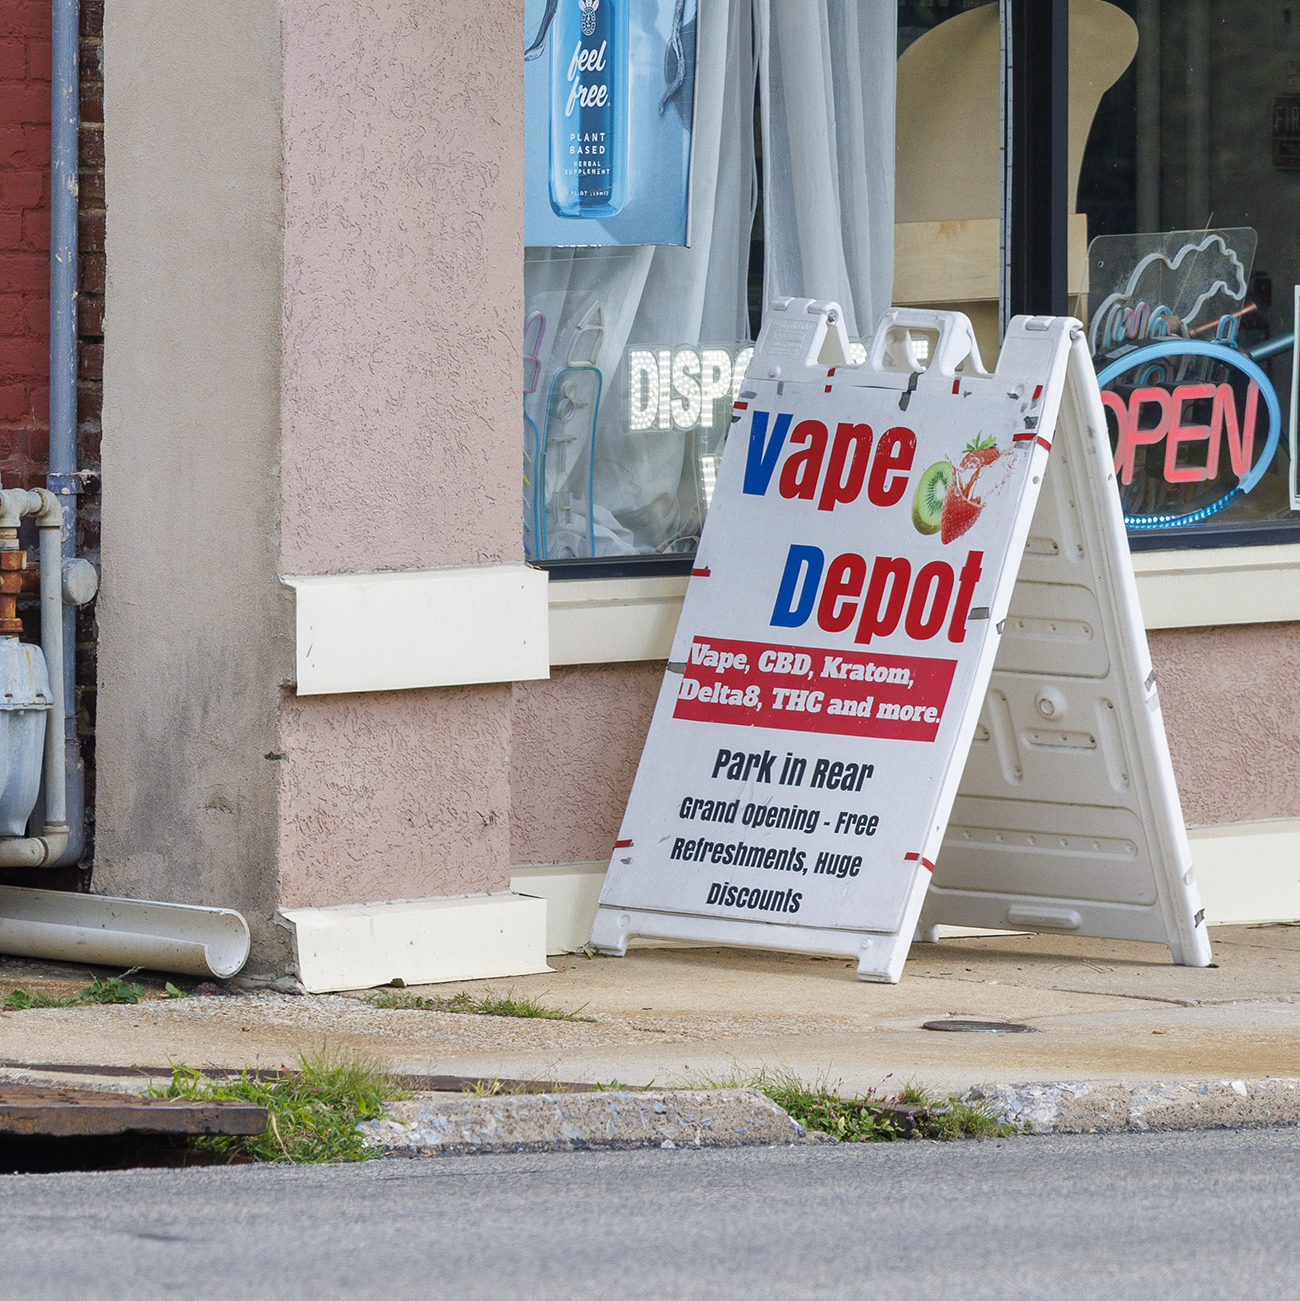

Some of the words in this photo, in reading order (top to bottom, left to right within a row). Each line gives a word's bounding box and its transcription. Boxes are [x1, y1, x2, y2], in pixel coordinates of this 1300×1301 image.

[567, 40, 607, 82] feel
[569, 145, 606, 154] BASED
[570, 132, 606, 142] PLANT
[743, 410, 917, 511] Vape
[770, 544, 984, 643] Depot
[690, 643, 750, 674] Vape,
[758, 650, 813, 680] CBD,
[820, 656, 914, 688] Kratom,
[678, 678, 762, 711] Delta8,
[772, 687, 825, 713] THC
[827, 697, 874, 717] and
[876, 703, 940, 723] more.
[712, 749, 777, 783] Park
[779, 752, 807, 786] in
[810, 758, 874, 791] Rear
[679, 796, 740, 823] Grand
[834, 811, 879, 836] Free
[670, 837, 809, 876] Refreshments,
[813, 851, 863, 879] Huge
[706, 882, 803, 914] Discounts
